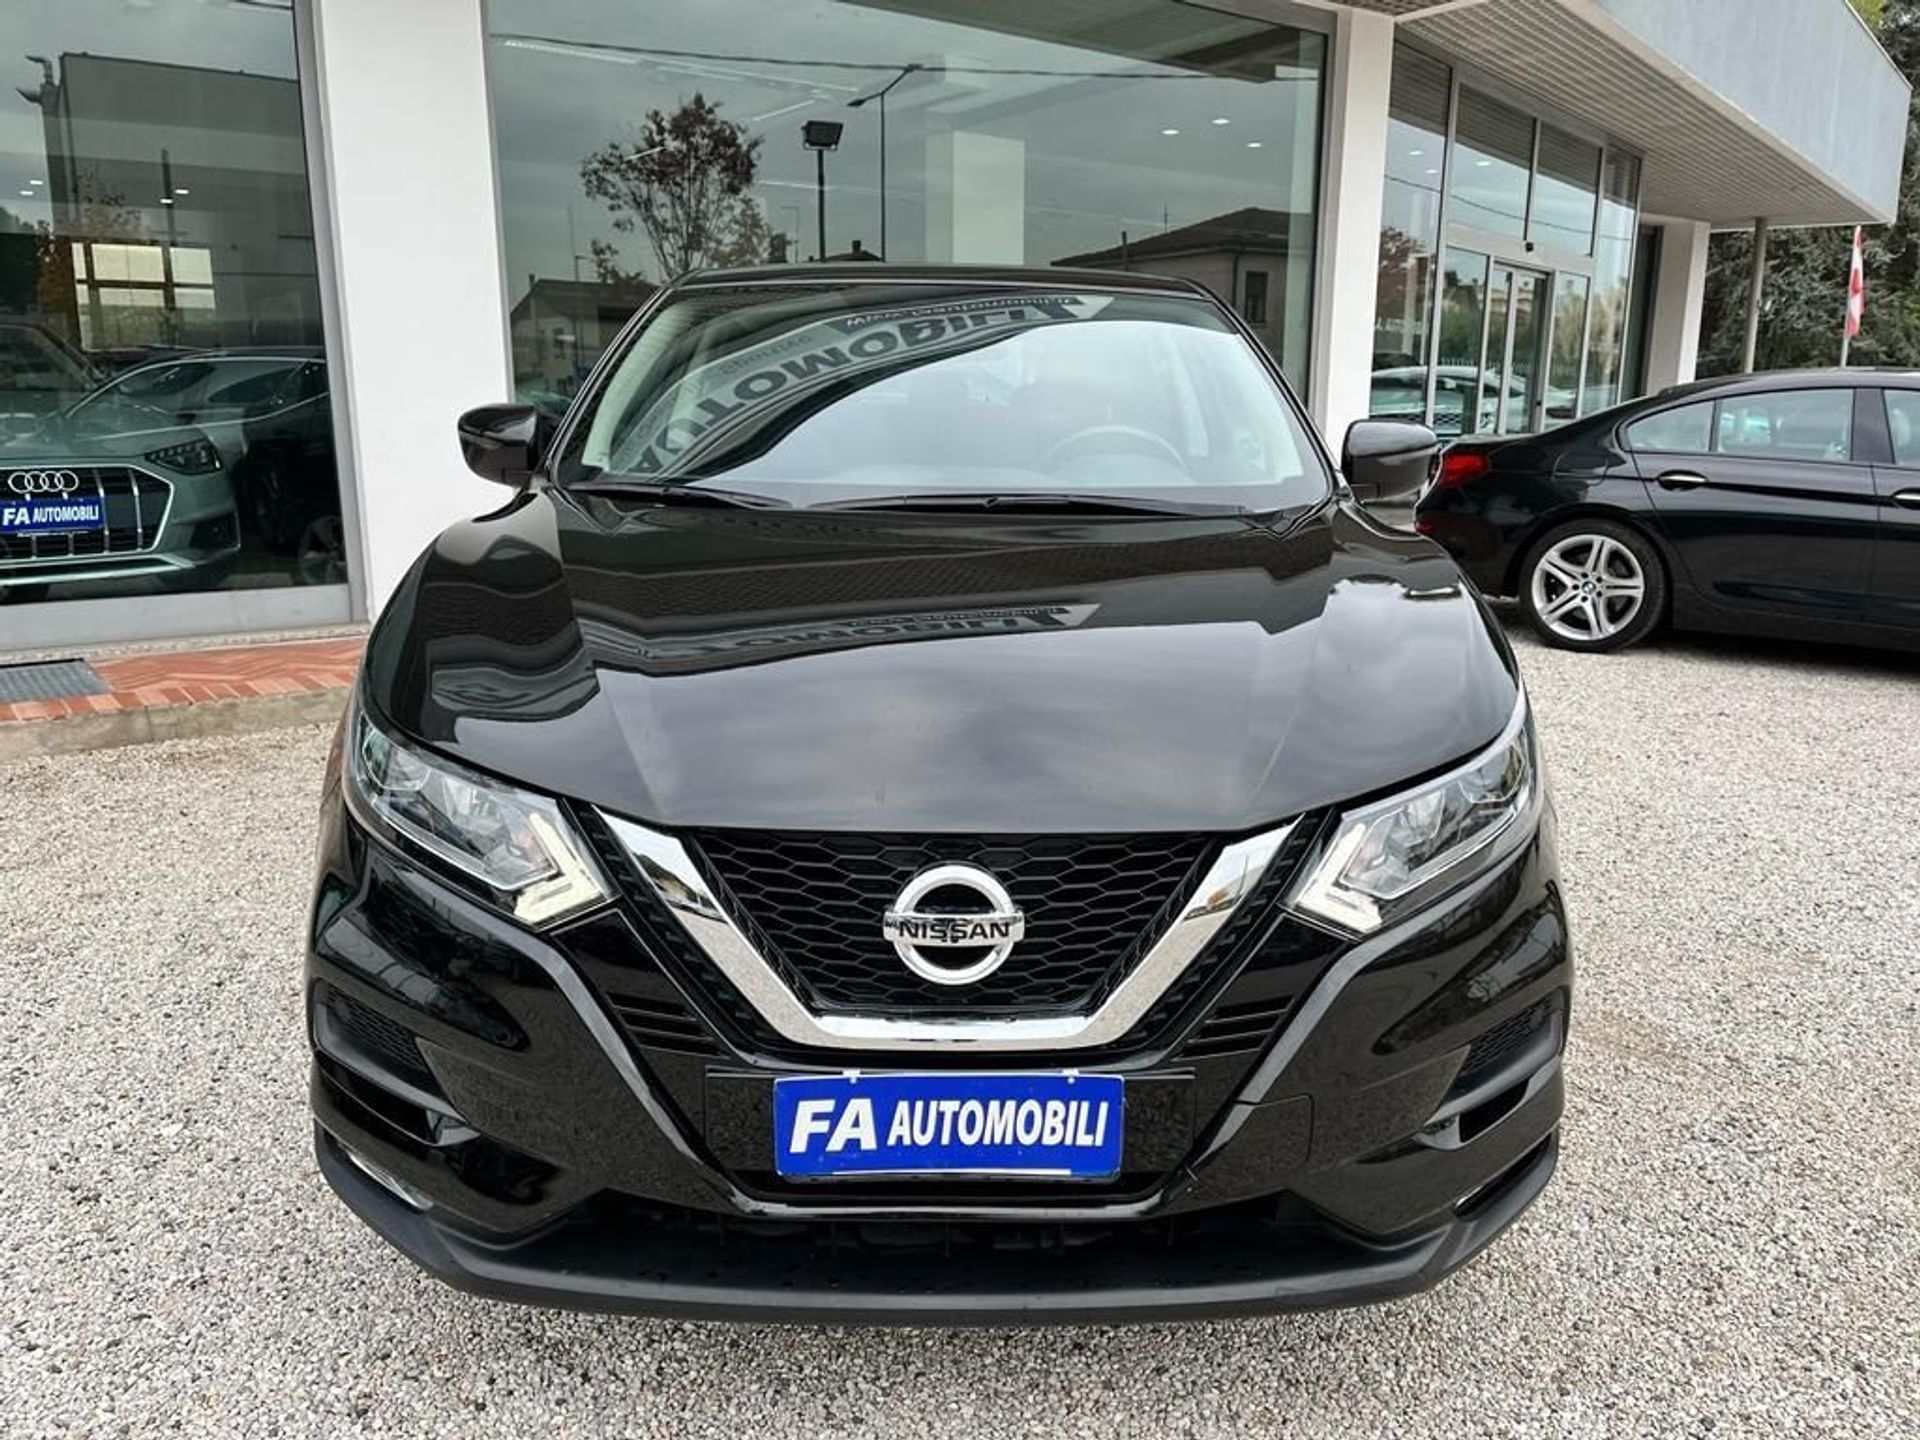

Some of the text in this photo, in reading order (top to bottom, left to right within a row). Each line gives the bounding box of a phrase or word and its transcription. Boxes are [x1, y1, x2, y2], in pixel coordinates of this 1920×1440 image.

[3, 505, 99, 526] FA AUTOMOBILI
[899, 921, 1010, 940] NISSAN
[790, 1099, 1108, 1153] FA AUTOMOBILI
